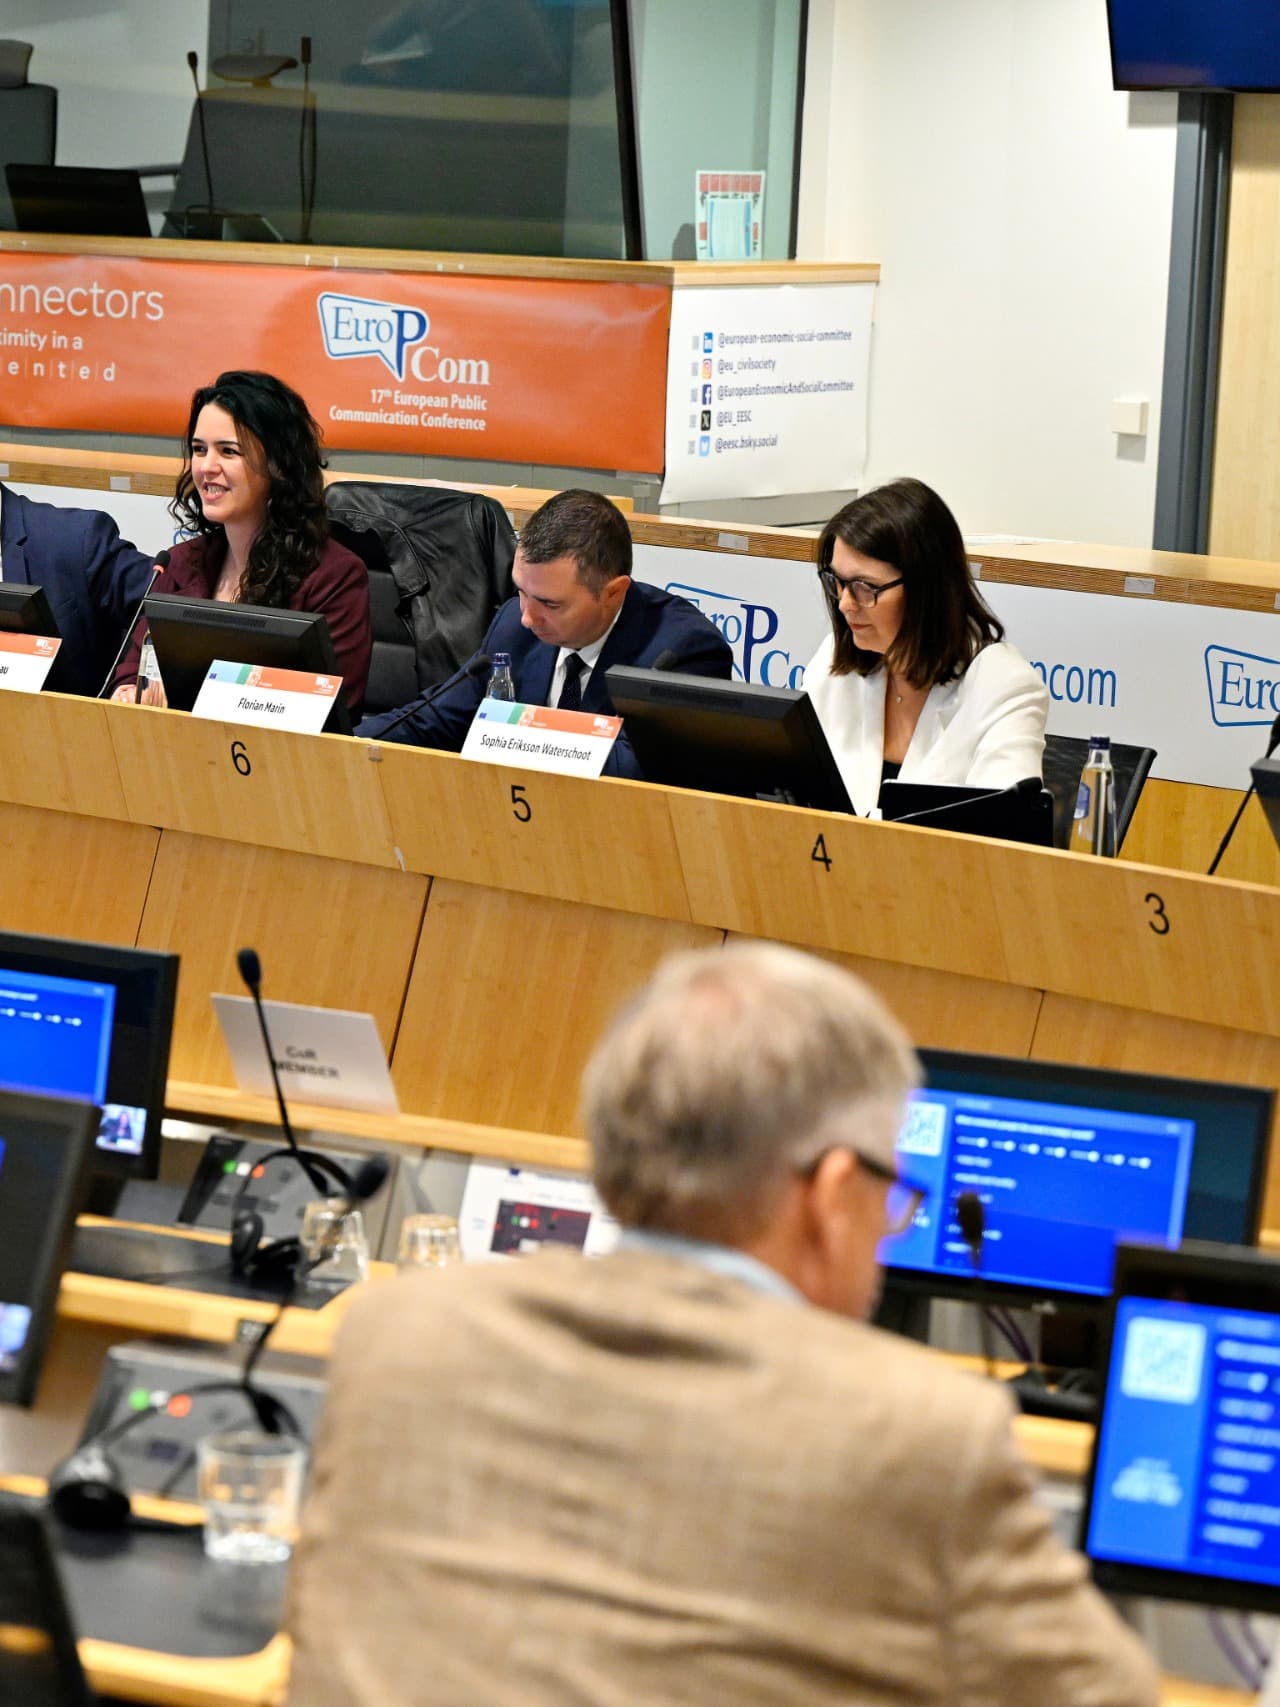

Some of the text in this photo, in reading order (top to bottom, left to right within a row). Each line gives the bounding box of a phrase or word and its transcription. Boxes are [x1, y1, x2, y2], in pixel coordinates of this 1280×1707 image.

[51, 330, 68, 349] in
[72, 336, 83, 350] a
[393, 390, 449, 410] European
[450, 393, 488, 411] Public
[329, 405, 487, 431] Communication Conference
[716, 410, 753, 427] @EU_EESC
[237, 697, 286, 715] Florian Marin
[230, 740, 252, 777] 6
[480, 734, 593, 761] Sophia Eriksson Waterschoot
[510, 785, 532, 823] 5
[810, 832, 833, 872] 4
[1144, 892, 1171, 935] 3
